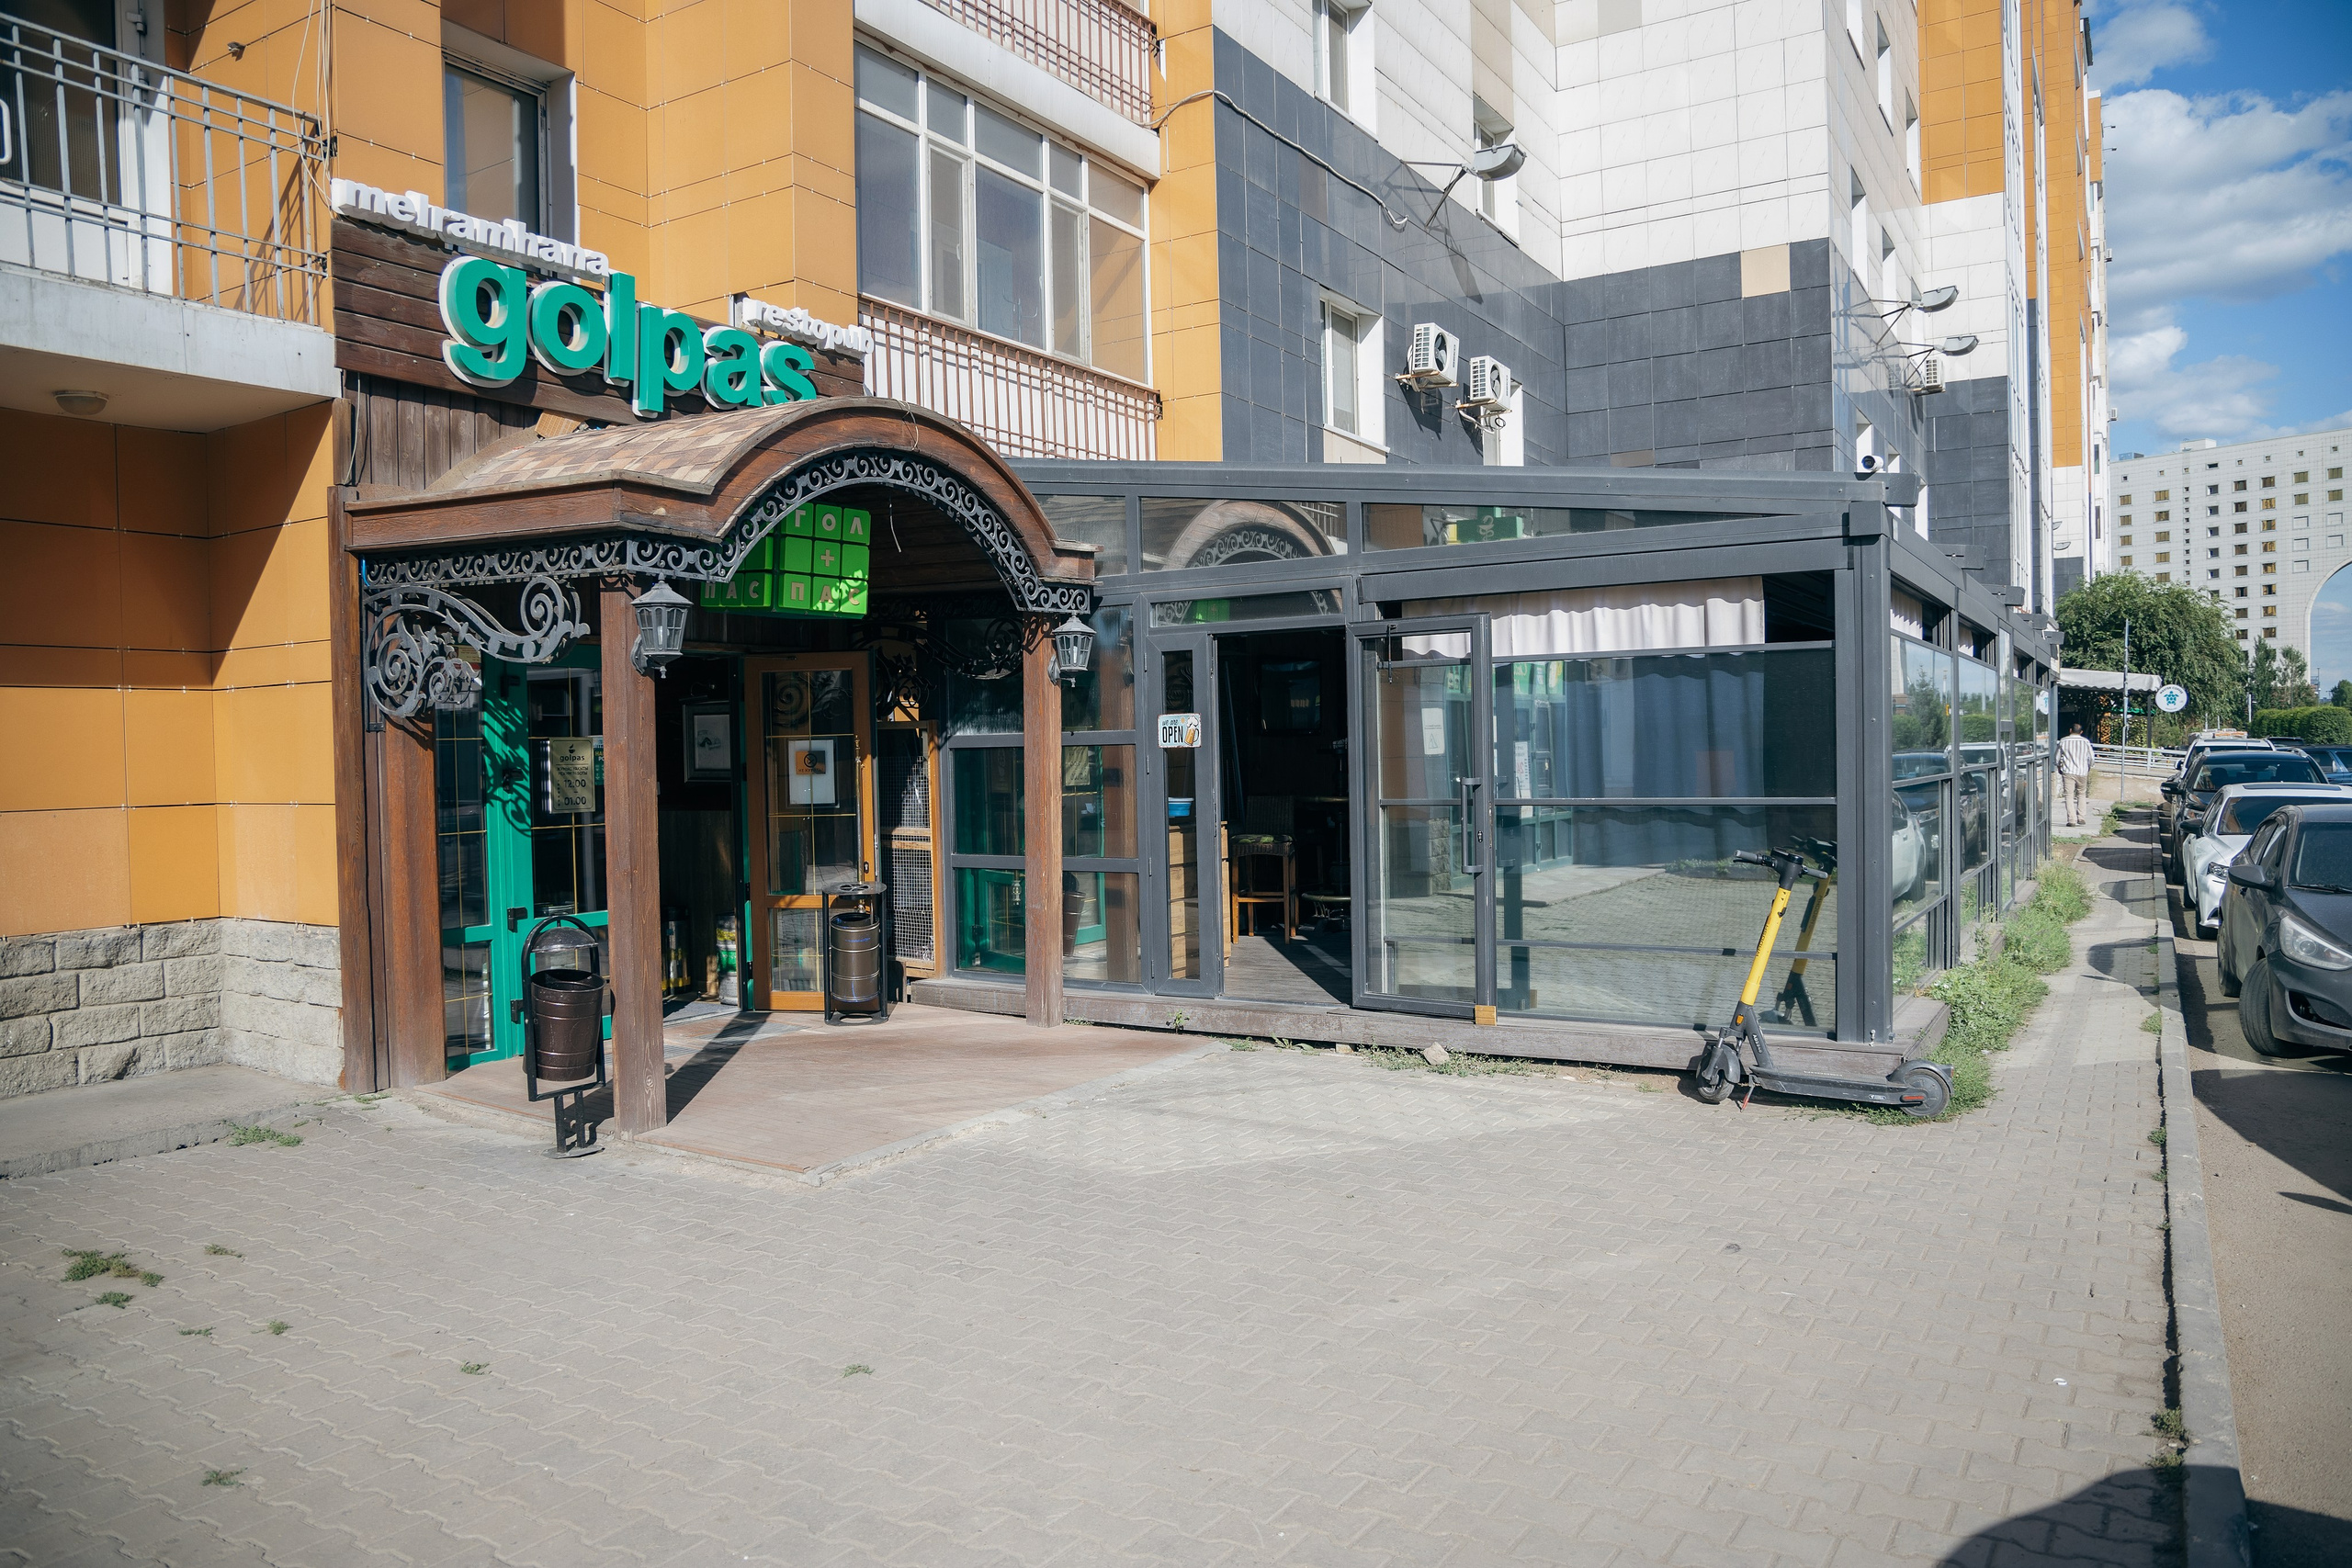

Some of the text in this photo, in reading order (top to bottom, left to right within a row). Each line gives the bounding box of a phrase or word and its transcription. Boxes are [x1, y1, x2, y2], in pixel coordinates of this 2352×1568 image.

[439, 256, 817, 417] golpas
[742, 297, 874, 358] restopub
[794, 509, 864, 536] ГОЛ
[705, 581, 760, 599] ПАС
[790, 581, 861, 606] ПАС
[1162, 726, 1183, 743] OPEN
[560, 754, 585, 762] golpas
